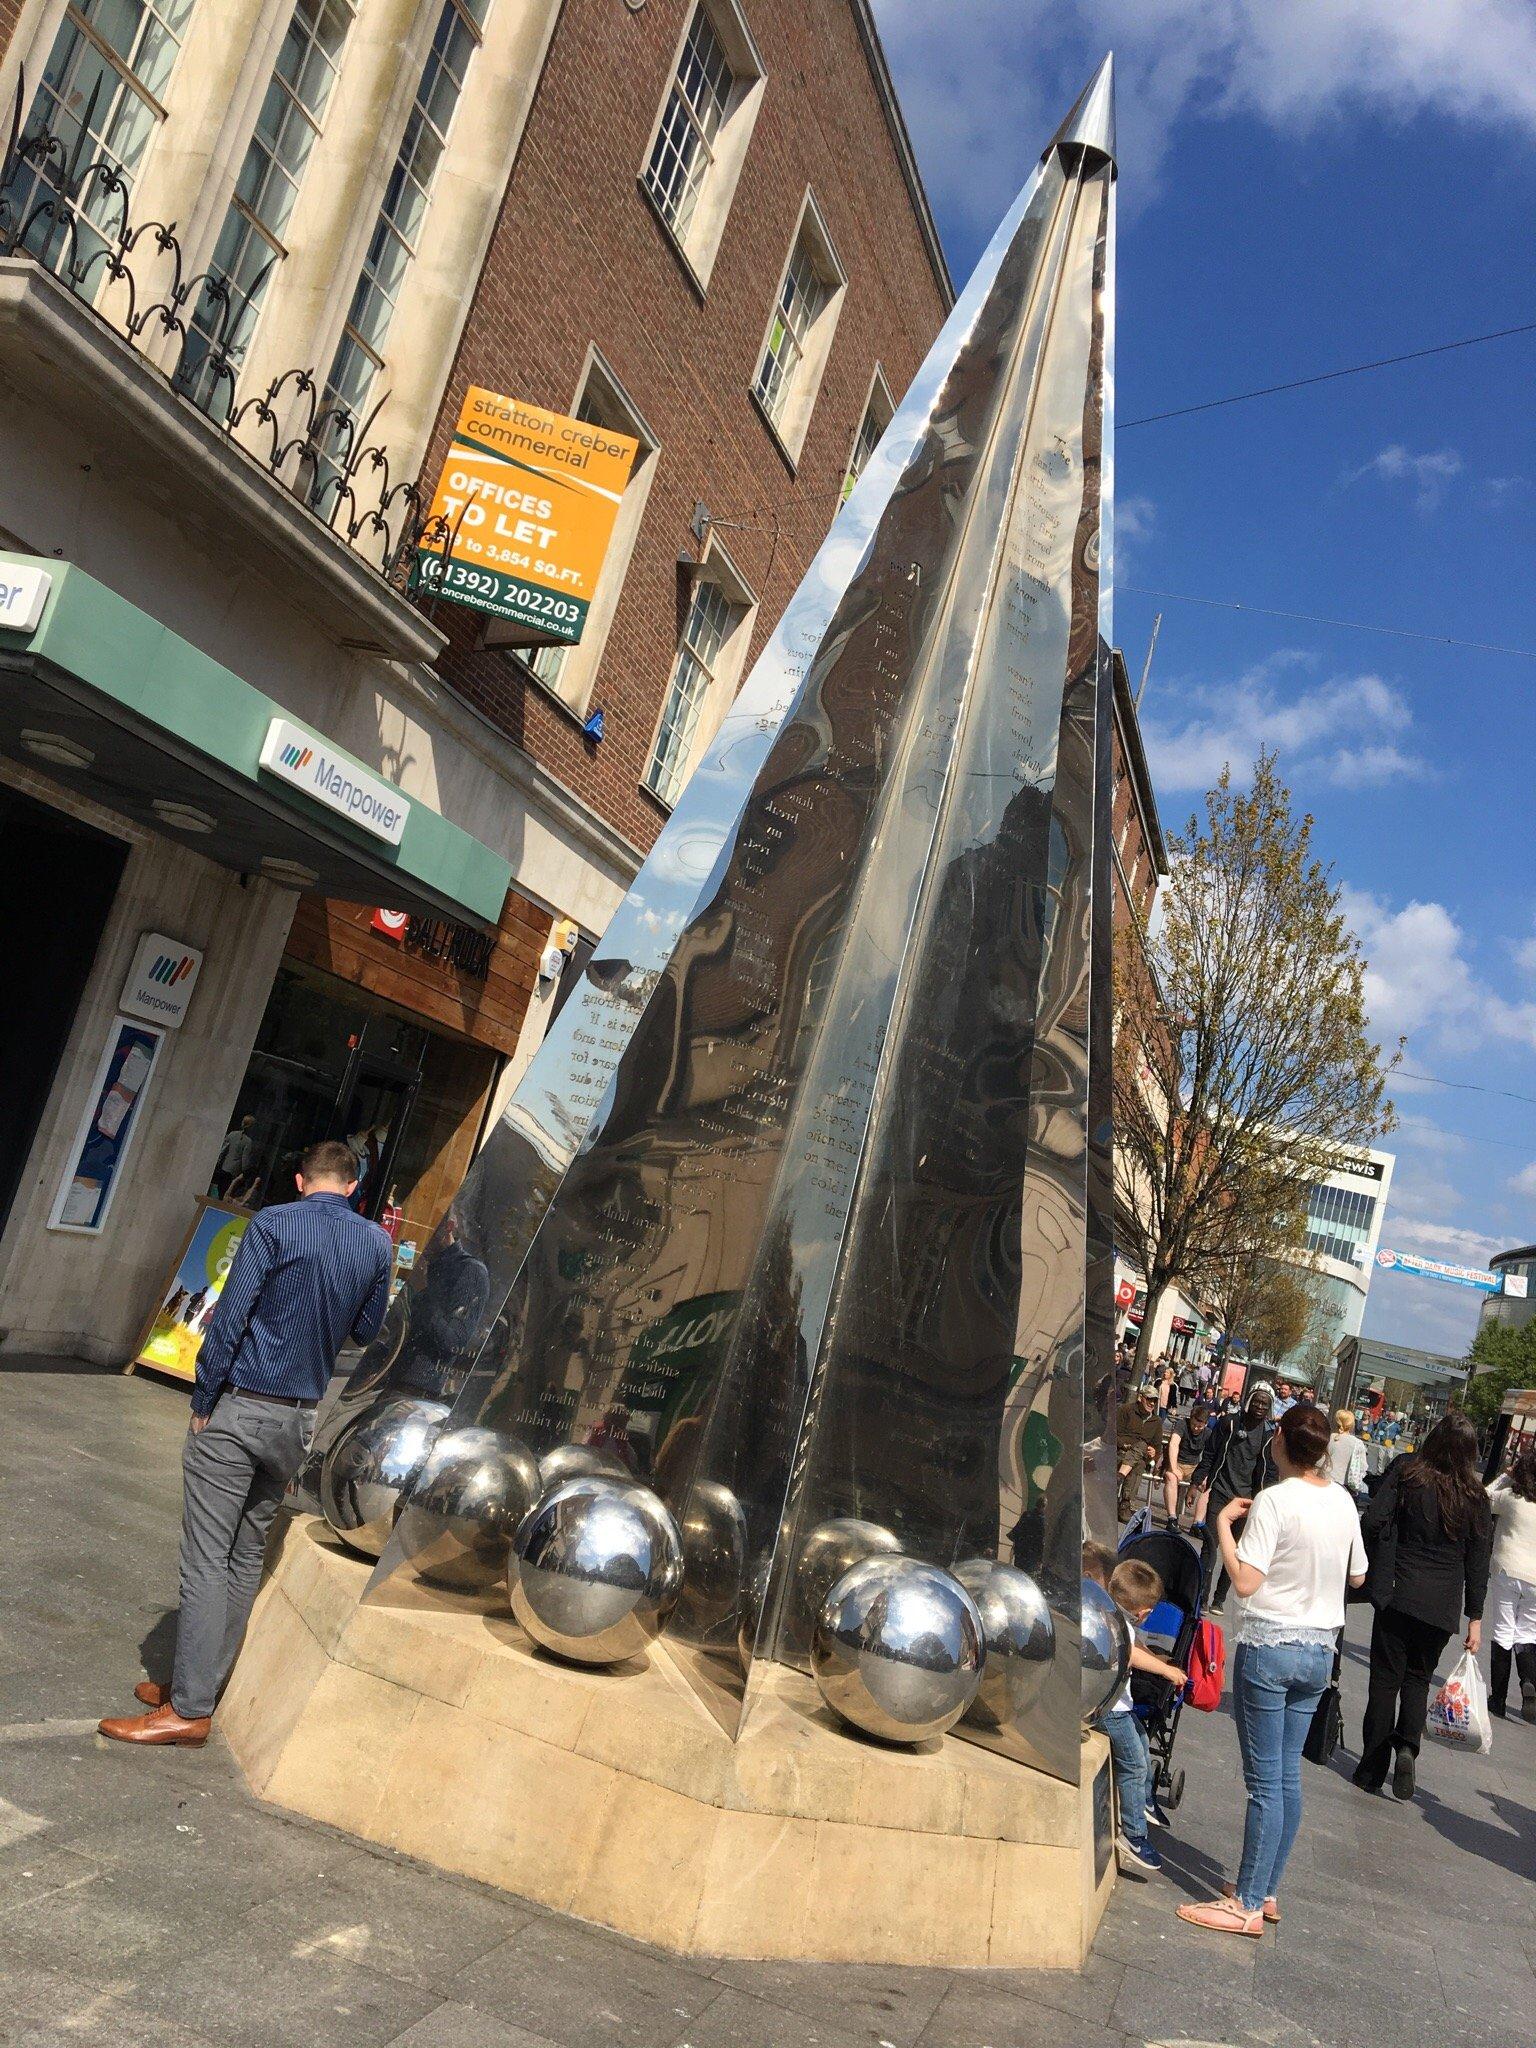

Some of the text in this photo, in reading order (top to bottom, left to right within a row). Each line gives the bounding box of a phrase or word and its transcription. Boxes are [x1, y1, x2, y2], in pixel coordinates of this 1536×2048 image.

[467, 419, 590, 469] commercial
[472, 399, 630, 461] stratton creber
[449, 471, 554, 519] OFFICES
[442, 495, 486, 527] TO
[494, 513, 558, 549] LET
[486, 543, 530, 569] 3,854
[504, 584, 581, 623] 202203
[1011, 706, 1033, 728] from
[1011, 728, 1035, 751] wool,
[1011, 750, 1043, 778] skilfully
[314, 757, 402, 831] Manpower
[136, 988, 182, 1016] Manpower
[804, 1152, 819, 1164] on
[1444, 1266, 1465, 1278] MUSIC
[1466, 1270, 1497, 1285] FESTIVAL
[1433, 1726, 1466, 1741] TESCO
